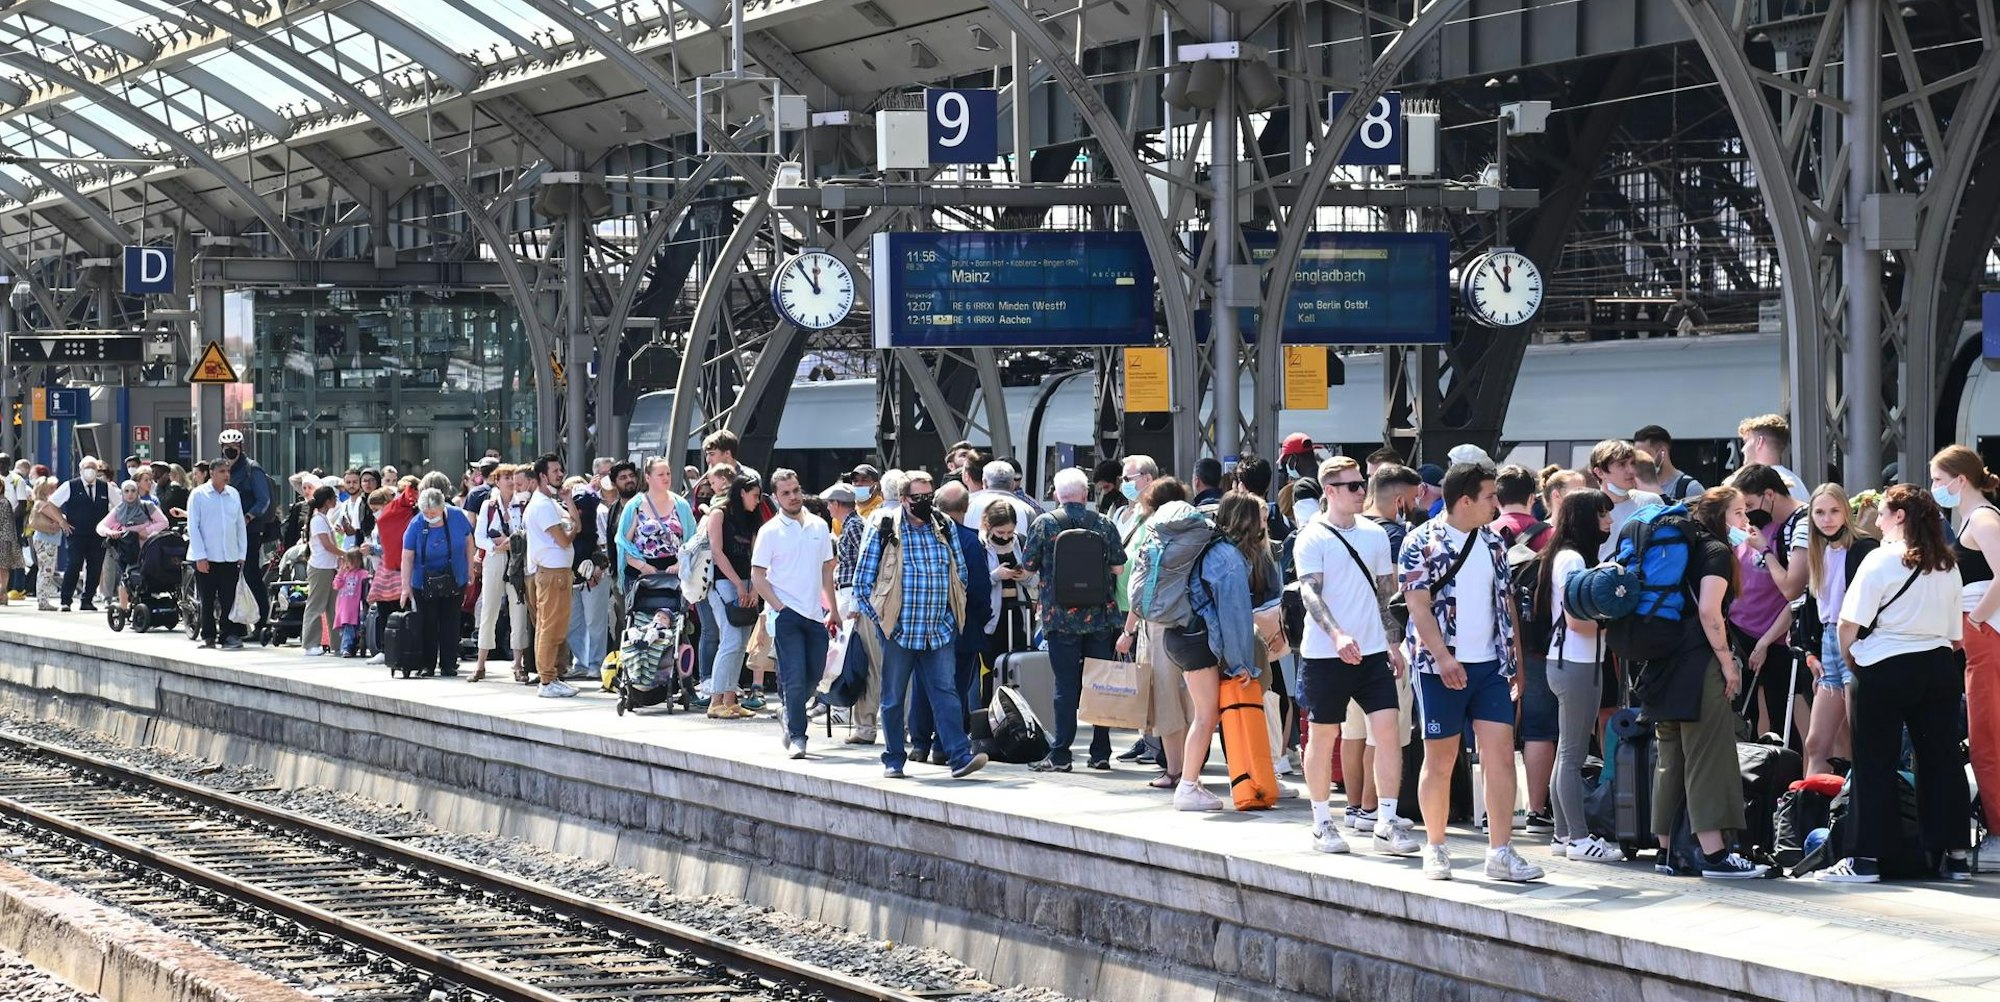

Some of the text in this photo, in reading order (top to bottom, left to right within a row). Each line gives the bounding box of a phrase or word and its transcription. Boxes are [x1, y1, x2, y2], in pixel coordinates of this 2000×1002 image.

[936, 91, 970, 147] 9
[1360, 96, 1393, 149] 8
[906, 250, 936, 262] 11:56
[141, 249, 167, 283] D
[951, 269, 990, 283] Mainz
[906, 301, 932, 312] 12:07
[952, 302, 963, 311] RE
[965, 302, 971, 311] 6
[998, 301, 1029, 311] Minden
[1032, 301, 1067, 311] (Westf)
[1298, 302, 1314, 310] von
[1317, 300, 1341, 310] Berlin
[906, 314, 932, 325] 12:15
[952, 315, 963, 324] RE
[999, 314, 1032, 324] Aachen
